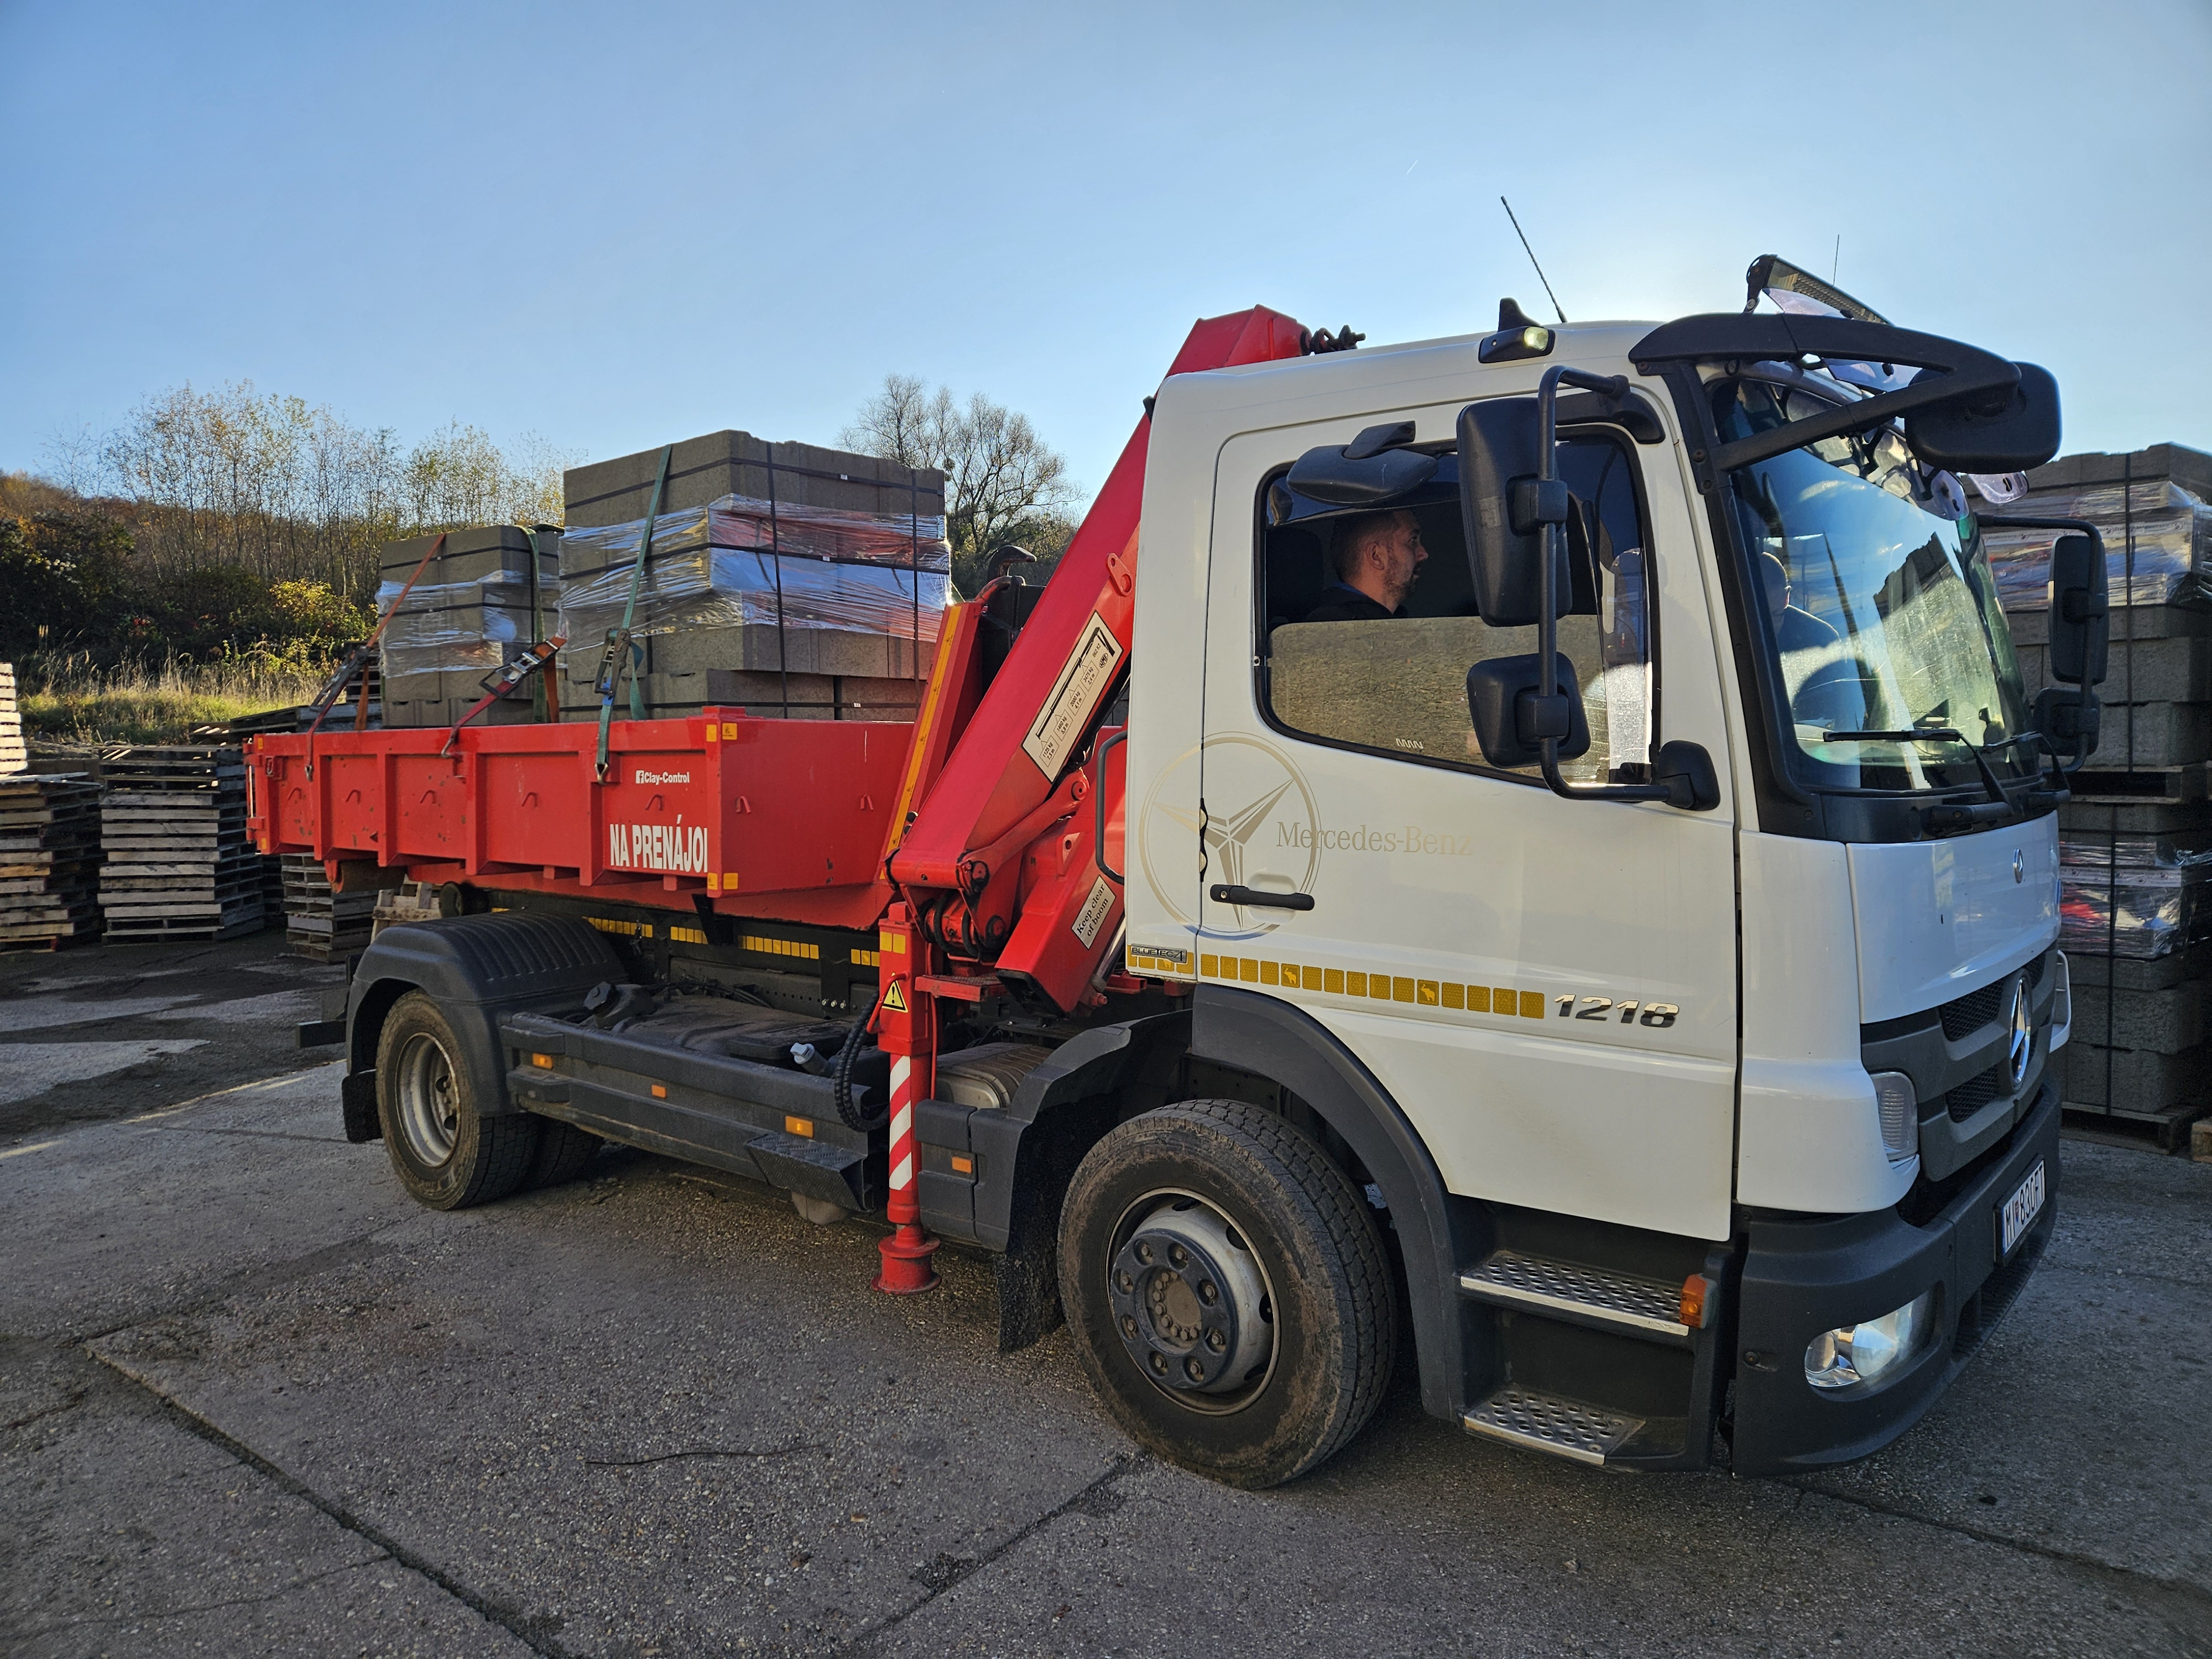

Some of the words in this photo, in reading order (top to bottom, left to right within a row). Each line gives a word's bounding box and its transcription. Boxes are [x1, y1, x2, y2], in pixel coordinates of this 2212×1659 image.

[1100, 654, 1108, 667] HMF
[644, 771, 690, 785] Clay-Control
[610, 824, 630, 867] NA
[632, 814, 708, 873] PRENÁJO
[1276, 821, 1473, 856] Mercedes-Benz
[1077, 909, 1092, 935] Keep
[1092, 884, 1105, 909] clear
[1087, 917, 1095, 937] of
[1092, 898, 1108, 924] boom
[1554, 993, 1679, 1028] 1218
